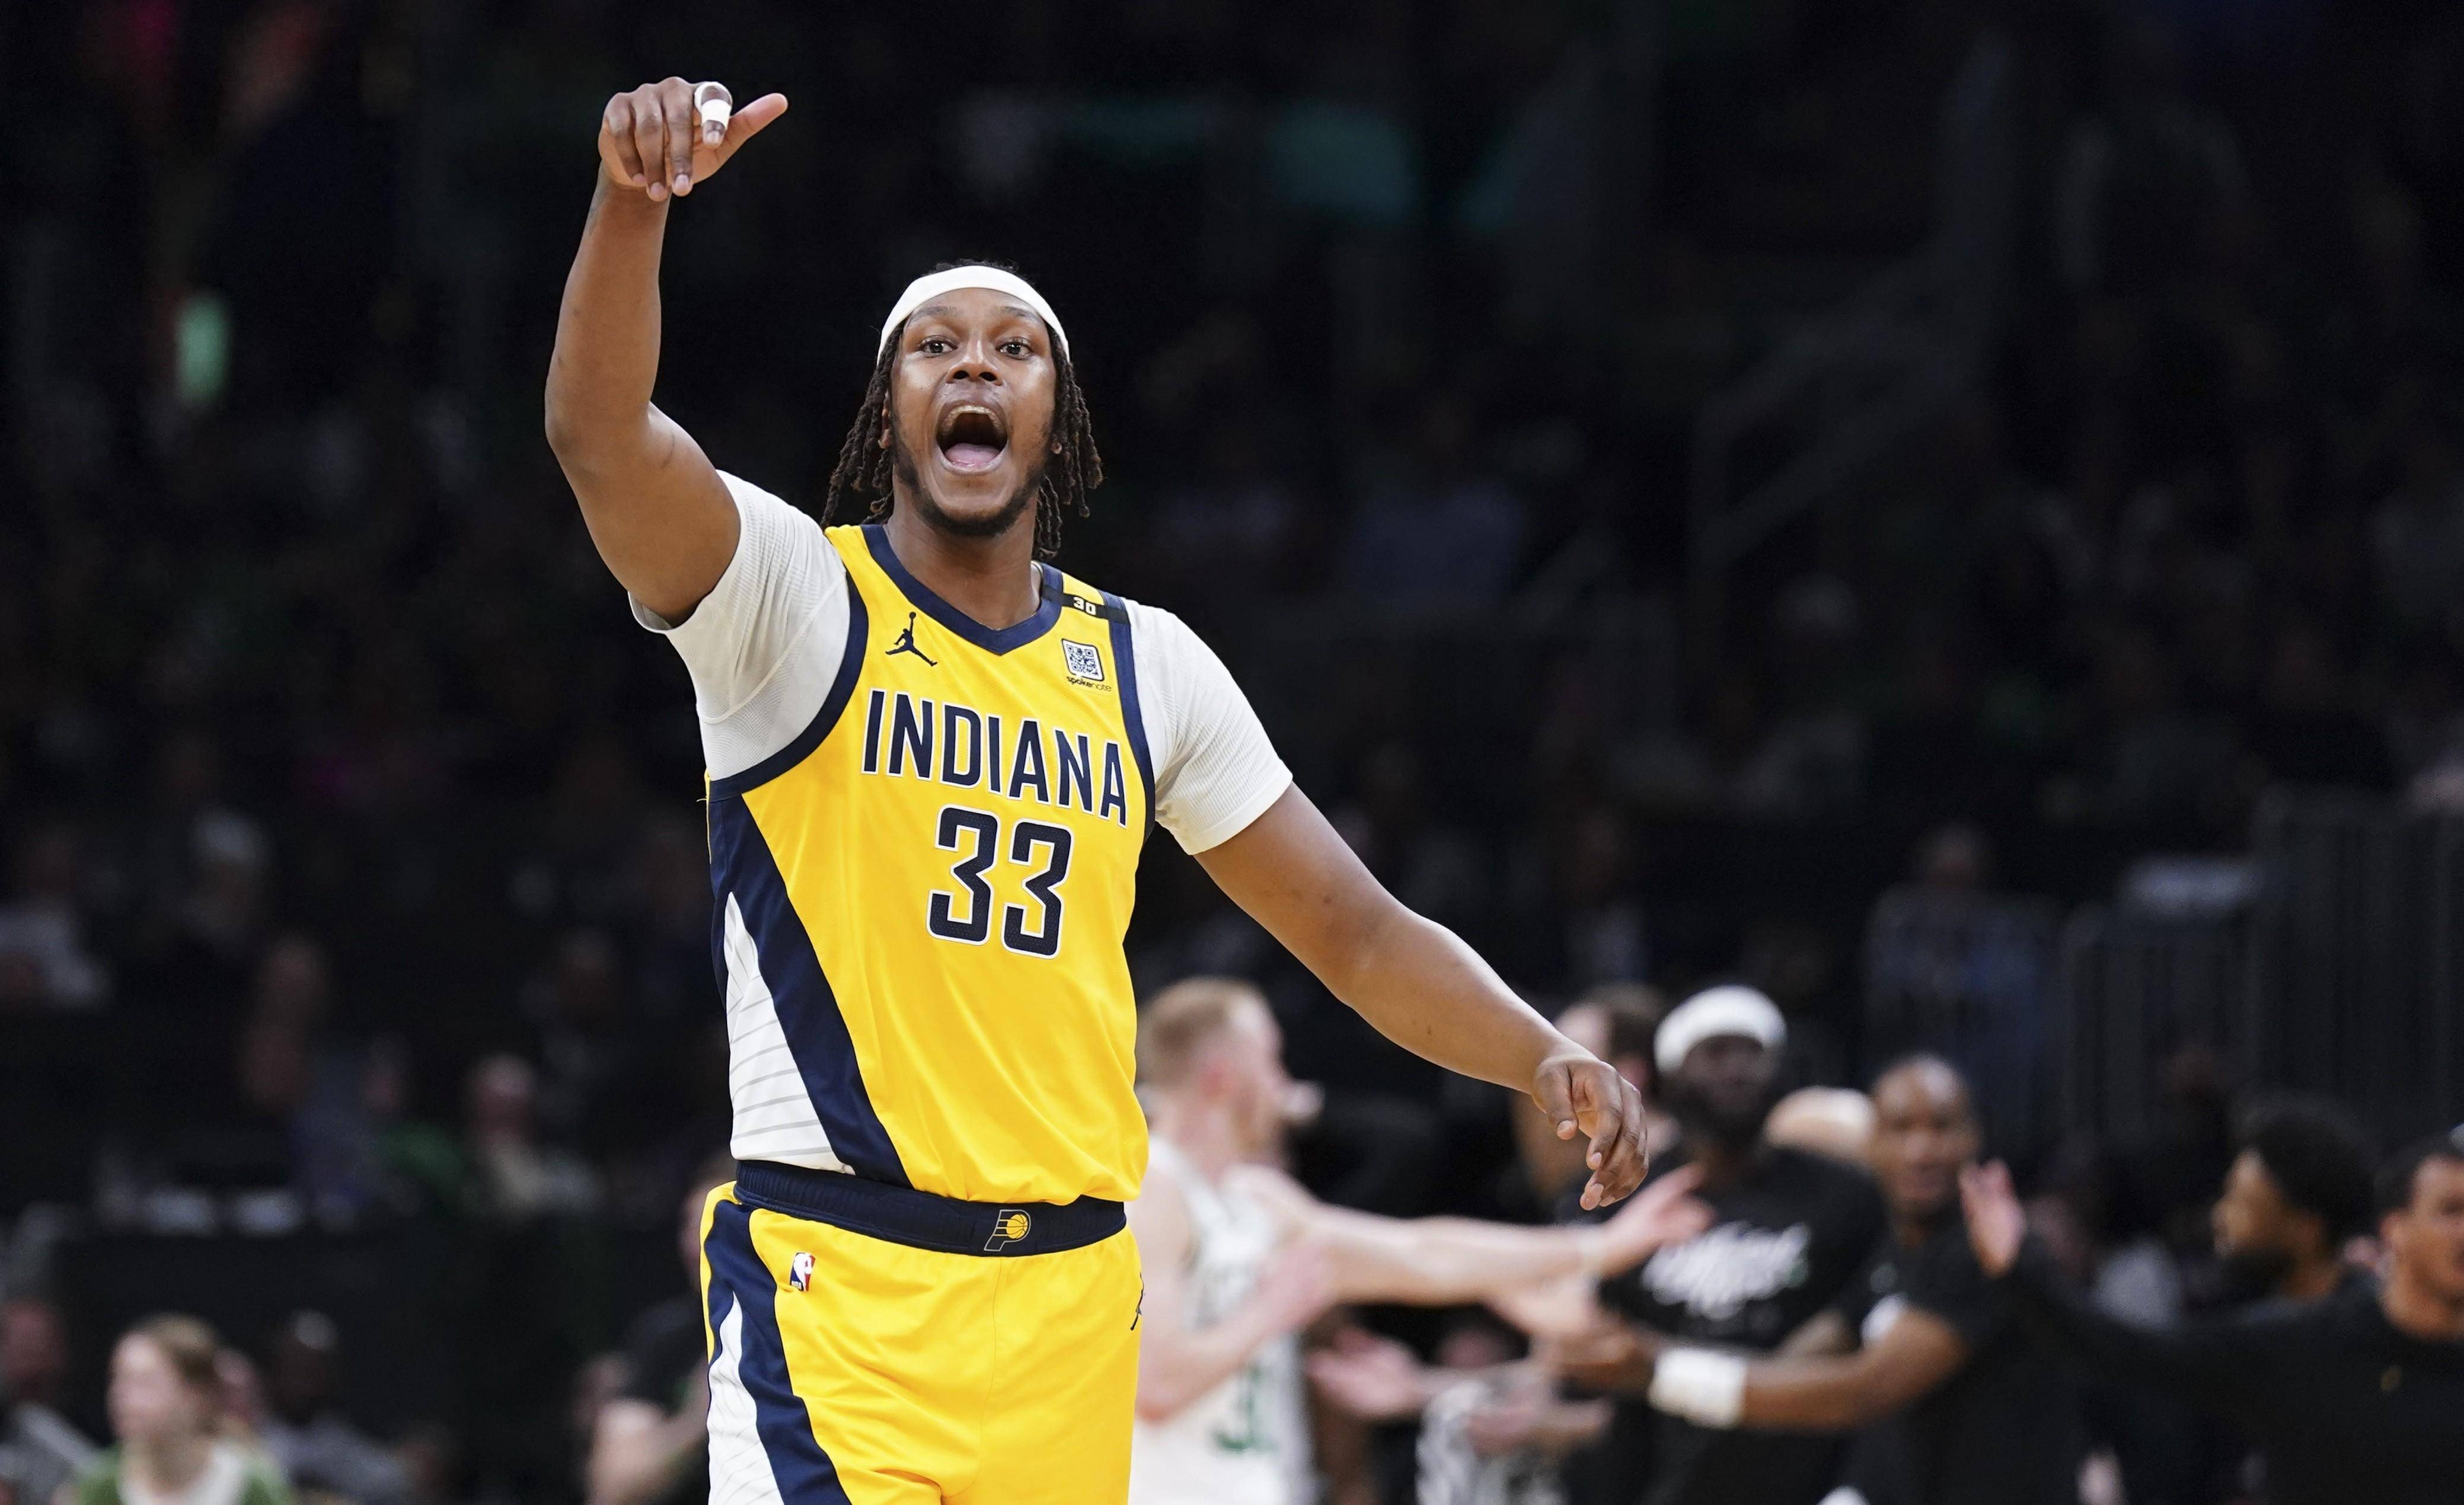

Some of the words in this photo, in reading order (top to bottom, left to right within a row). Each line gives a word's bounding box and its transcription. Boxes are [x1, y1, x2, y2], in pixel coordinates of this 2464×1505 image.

[1073, 596, 1096, 615] 30
[1066, 676, 1112, 692] spokenote
[861, 688, 1128, 829] INDIANA
[925, 804, 1075, 960] 33
